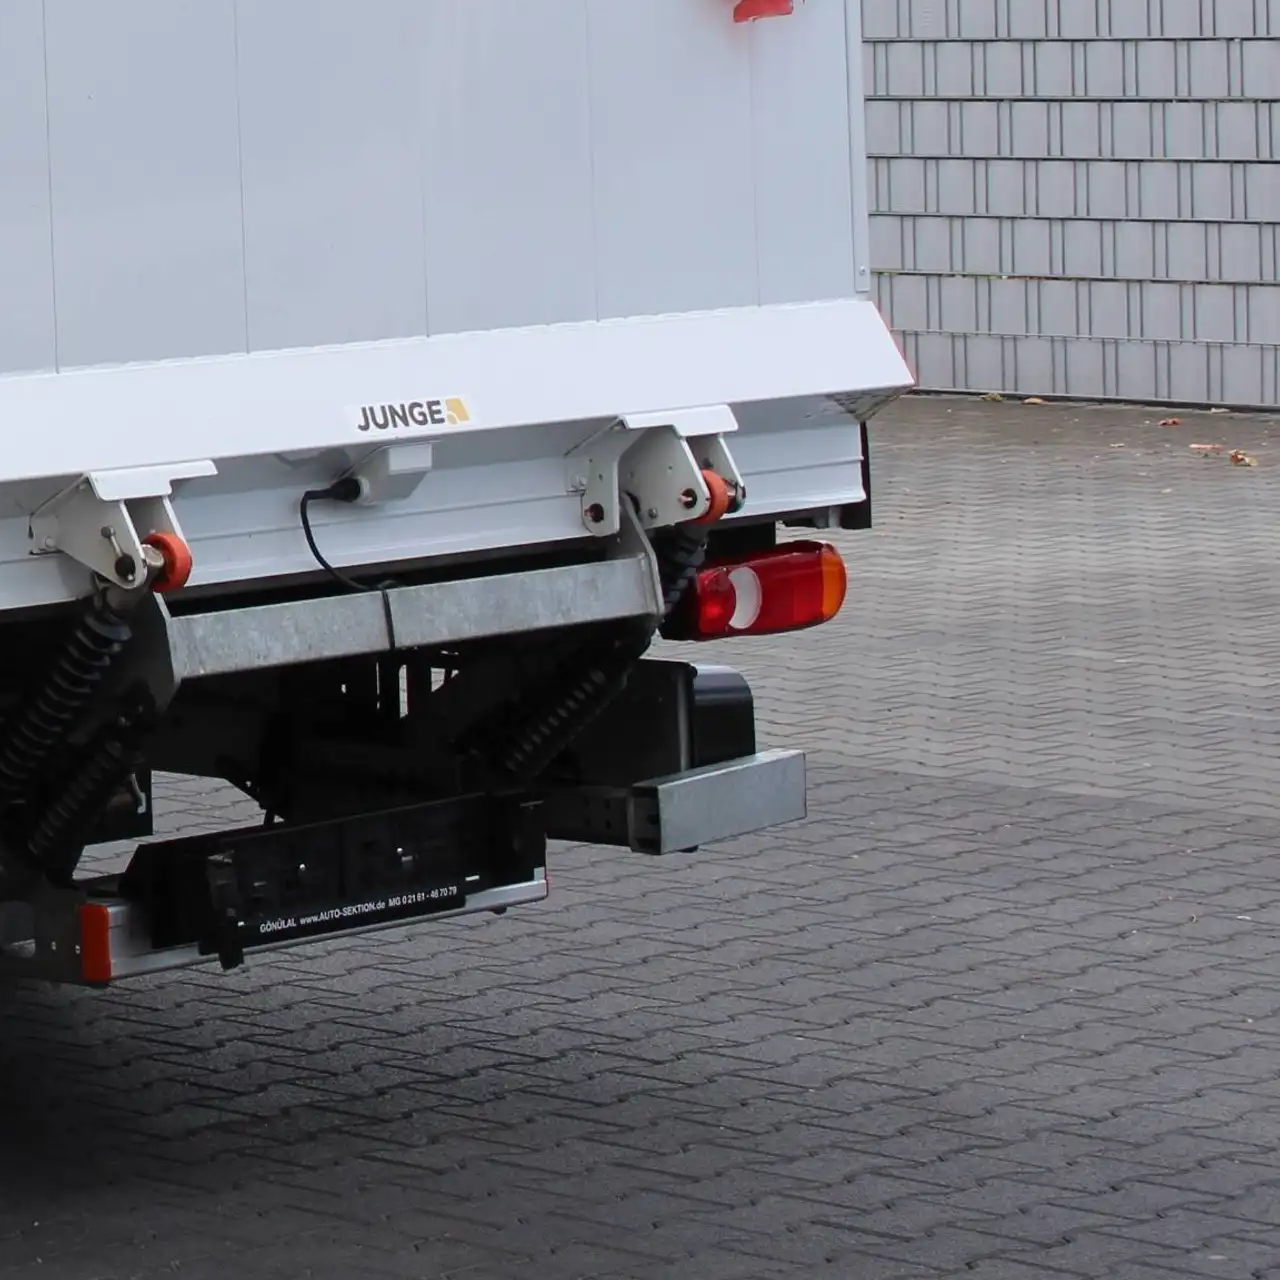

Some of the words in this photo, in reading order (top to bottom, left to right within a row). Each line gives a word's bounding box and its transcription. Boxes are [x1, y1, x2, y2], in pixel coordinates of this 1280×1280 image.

[357, 399, 445, 431] JUNGE
[260, 918, 297, 933] GÖNÜLAL
[300, 900, 386, 925] www.AUTO-SEKTION.de
[388, 896, 401, 907] MG
